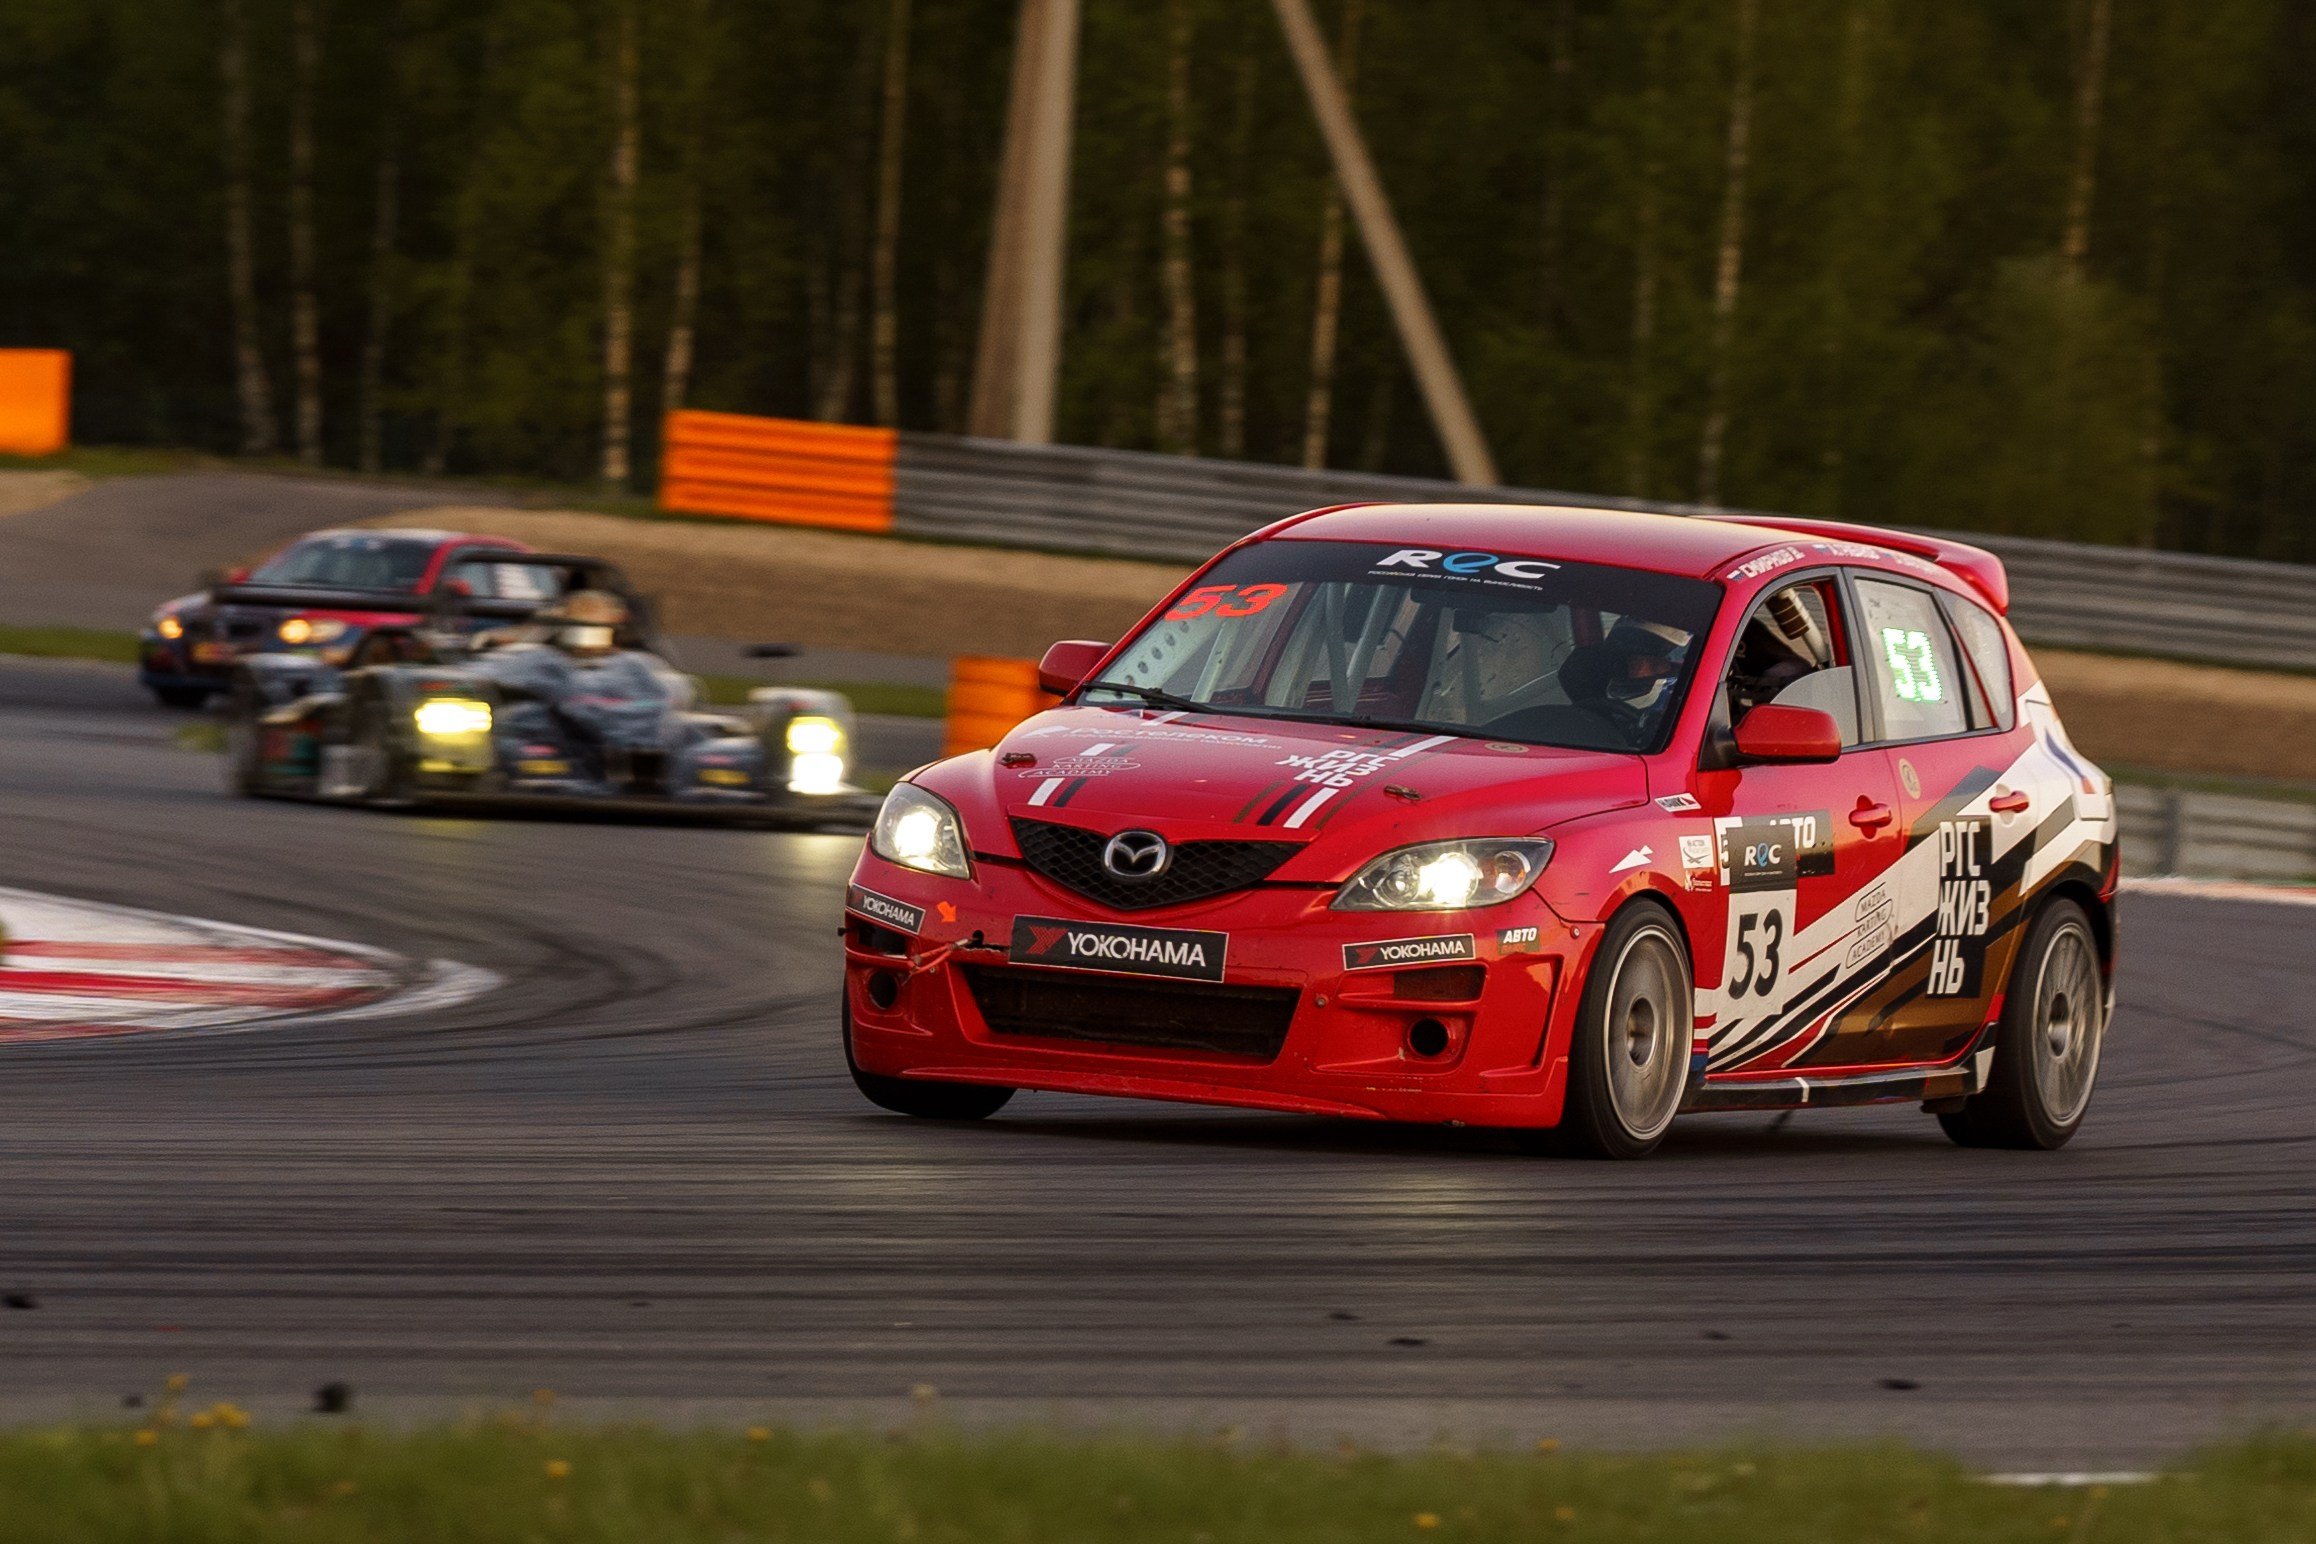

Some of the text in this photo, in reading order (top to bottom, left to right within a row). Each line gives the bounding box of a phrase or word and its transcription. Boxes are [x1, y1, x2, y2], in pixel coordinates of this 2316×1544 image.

[1164, 583, 1288, 621] 53
[1882, 627, 1942, 701] 53
[1320, 750, 1399, 767] РГС
[1939, 821, 1981, 877] РГС
[863, 895, 915, 926] YOKOHAMA
[1861, 889, 1886, 913] MAZDA
[1937, 880, 1991, 936] ЖИЗ
[1503, 927, 1537, 944] АВТО
[1857, 908, 1887, 937] KARTING
[1067, 932, 1206, 967] YOKOHAMA
[1380, 940, 1466, 961] YOKOHAMA
[1728, 908, 1783, 1000] 53
[1852, 930, 1885, 960] ACADEMY
[1926, 939, 1965, 994] НЬ
